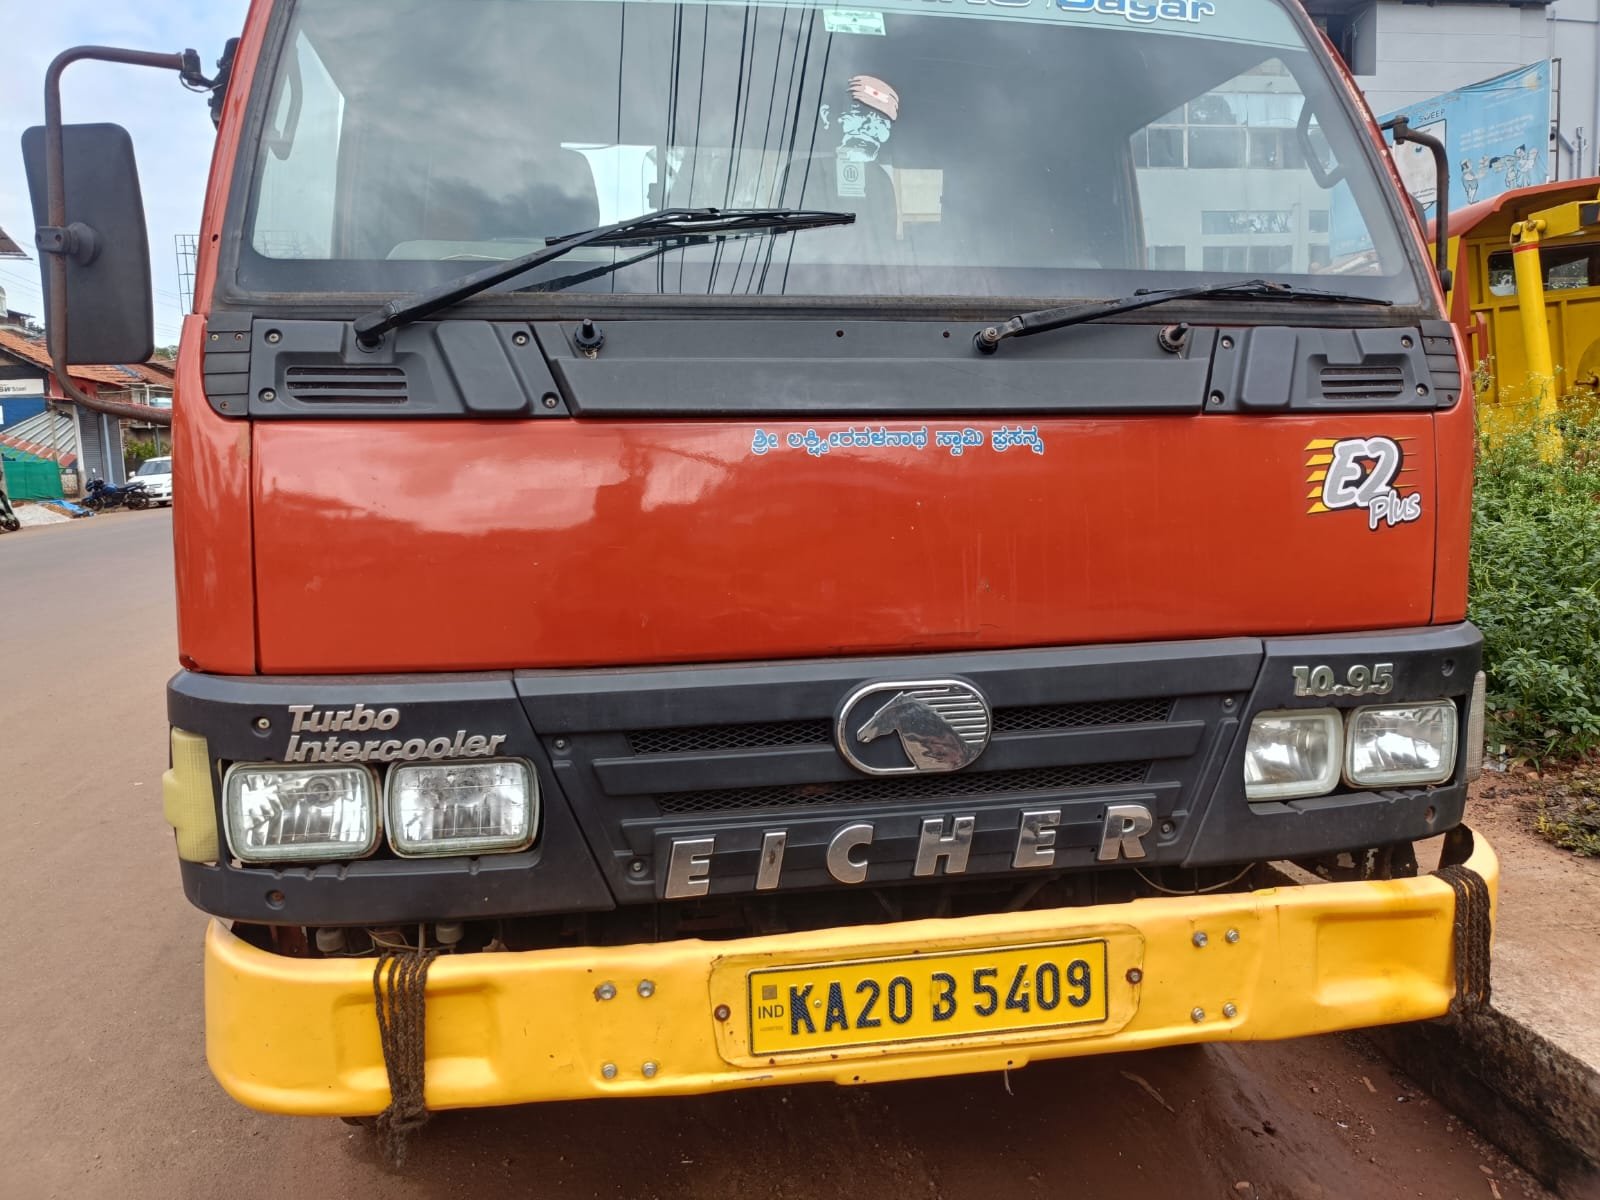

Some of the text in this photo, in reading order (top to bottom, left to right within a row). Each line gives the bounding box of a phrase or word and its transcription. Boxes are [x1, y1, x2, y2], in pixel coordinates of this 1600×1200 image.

[751, 428, 778, 454] ಶ್ರೀ
[935, 427, 984, 456] ಸ್ವಾಮಿ
[991, 426, 1045, 455] ಪ್ರಸನ್ನ
[1322, 437, 1400, 509] E2
[288, 703, 400, 733] Turbo
[284, 729, 507, 762] Intercooler
[664, 804, 1155, 900] EICHER
[758, 1004, 784, 1019] IND
[788, 975, 913, 1035] KA20
[972, 959, 1092, 1017] 5409
